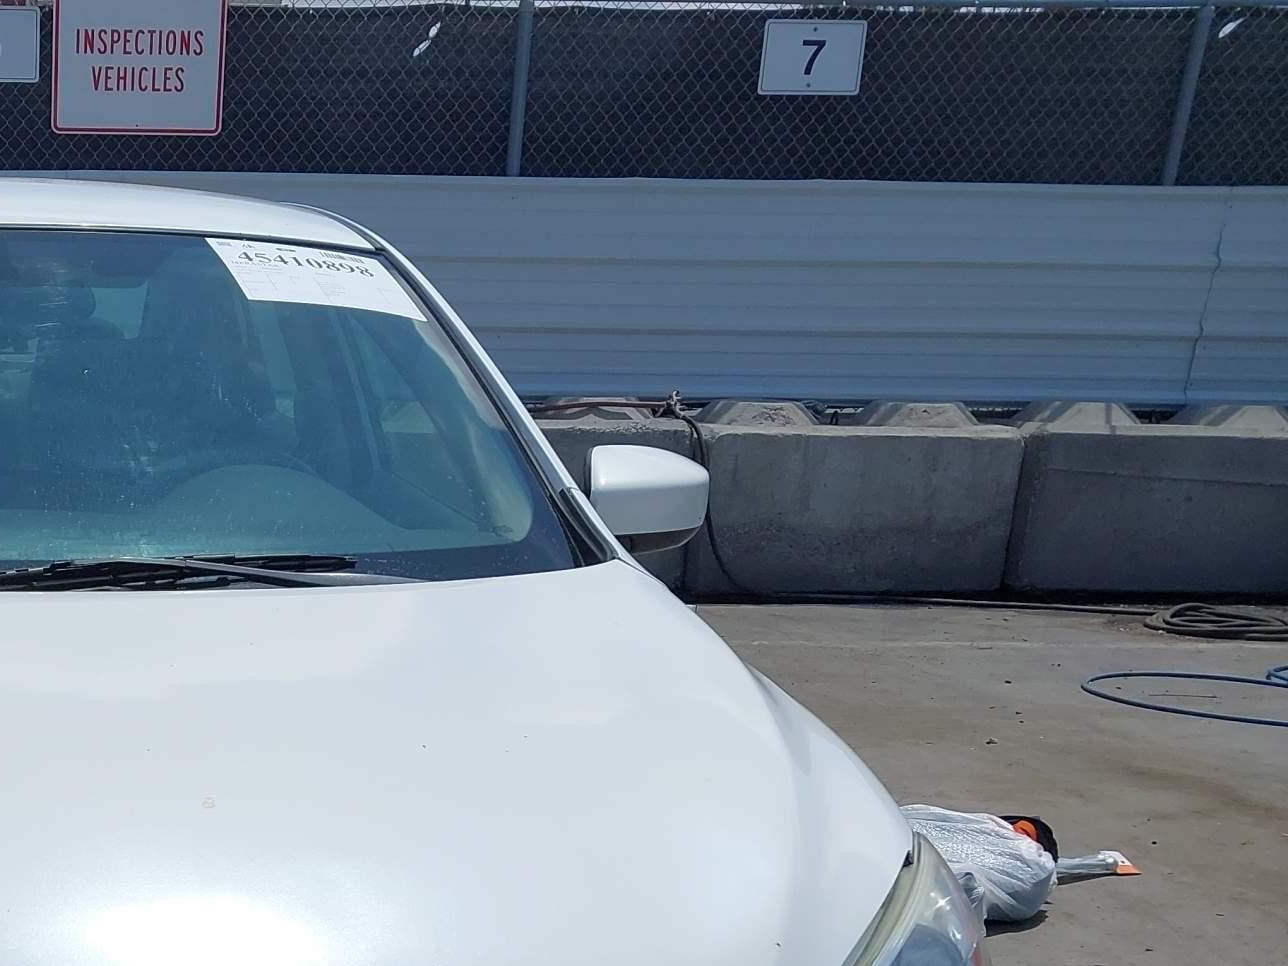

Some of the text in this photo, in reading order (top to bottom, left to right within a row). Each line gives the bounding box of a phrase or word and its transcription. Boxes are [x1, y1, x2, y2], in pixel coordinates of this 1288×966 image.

[75, 28, 205, 57] INSPECTIONS
[802, 39, 827, 76] 7
[91, 65, 186, 93] VEHICLES
[237, 250, 375, 278] 45410898
